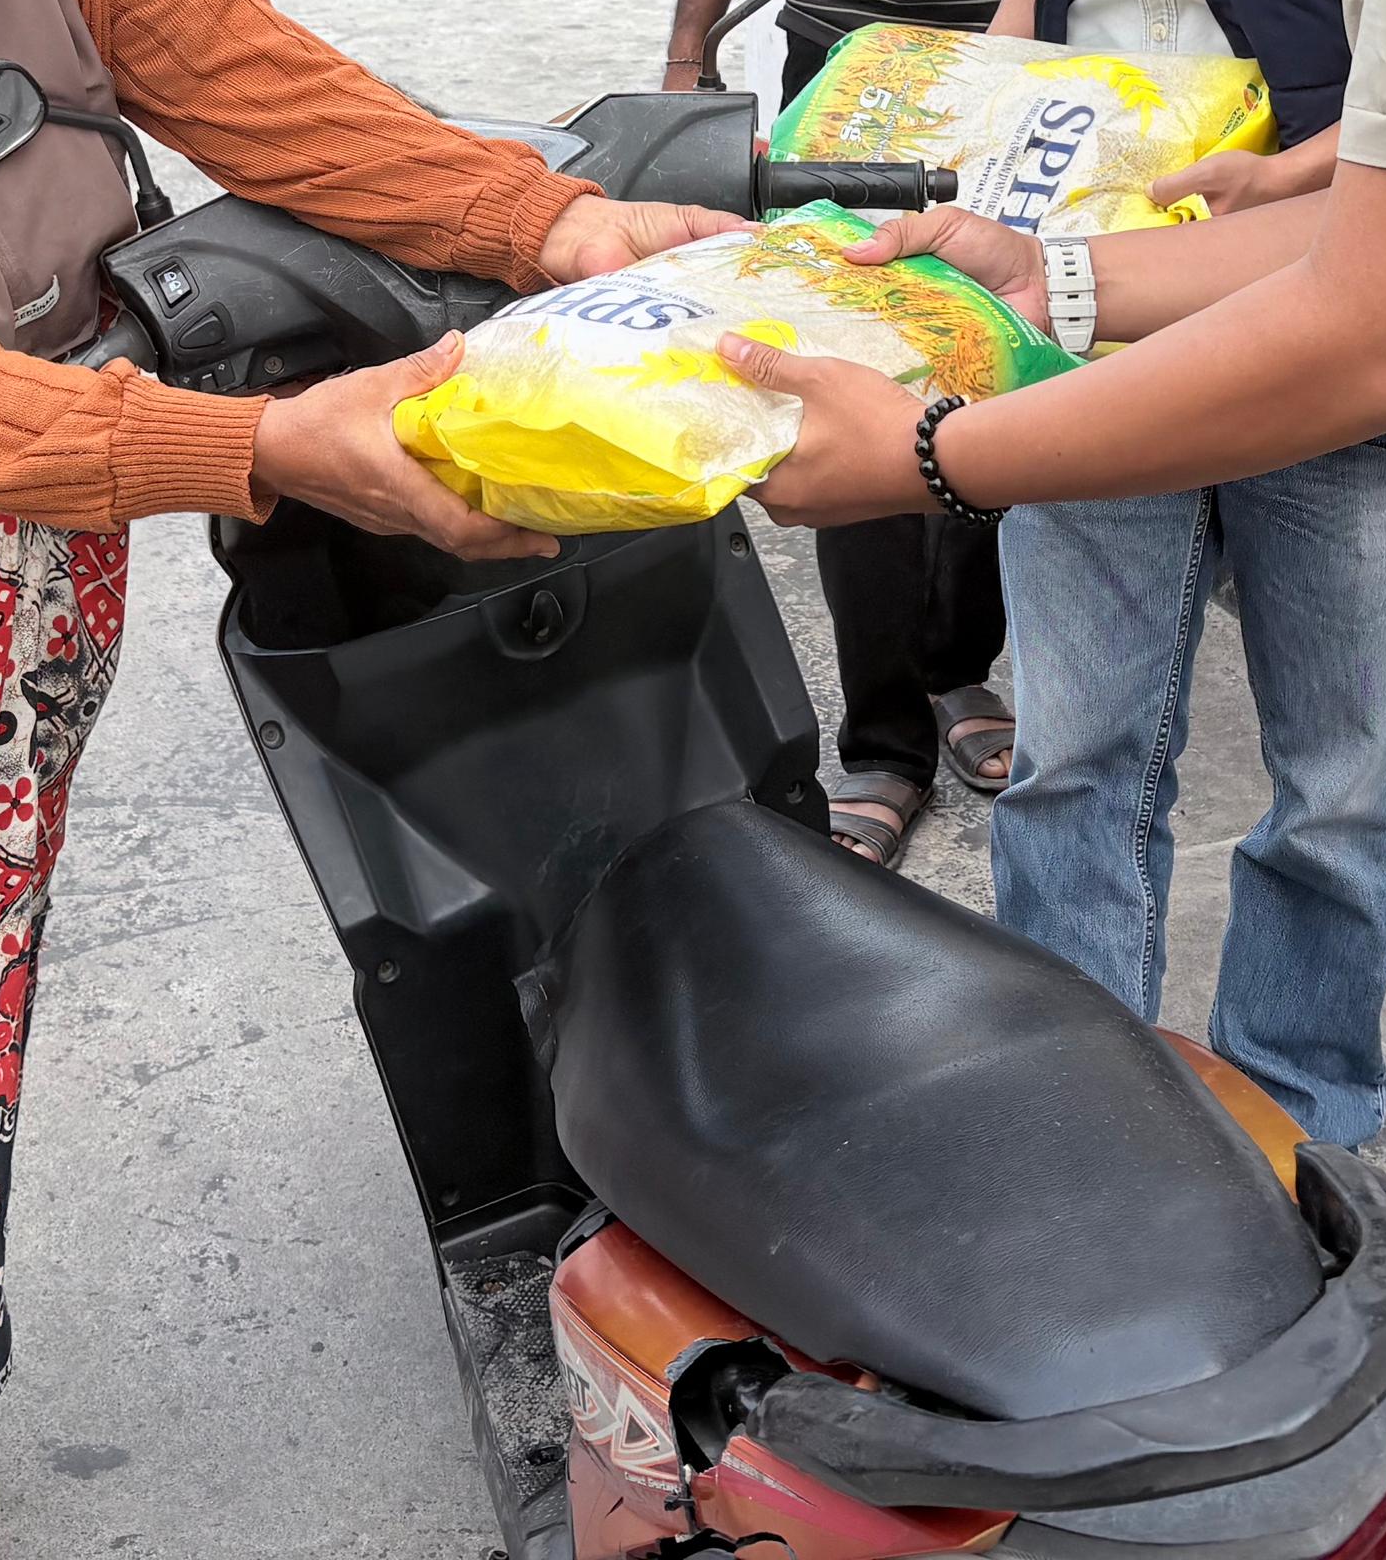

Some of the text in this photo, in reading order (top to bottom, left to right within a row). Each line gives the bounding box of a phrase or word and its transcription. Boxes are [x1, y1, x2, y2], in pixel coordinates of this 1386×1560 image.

[859, 86, 892, 110] 5
[839, 111, 872, 143] kg
[492, 286, 703, 330] SPH
